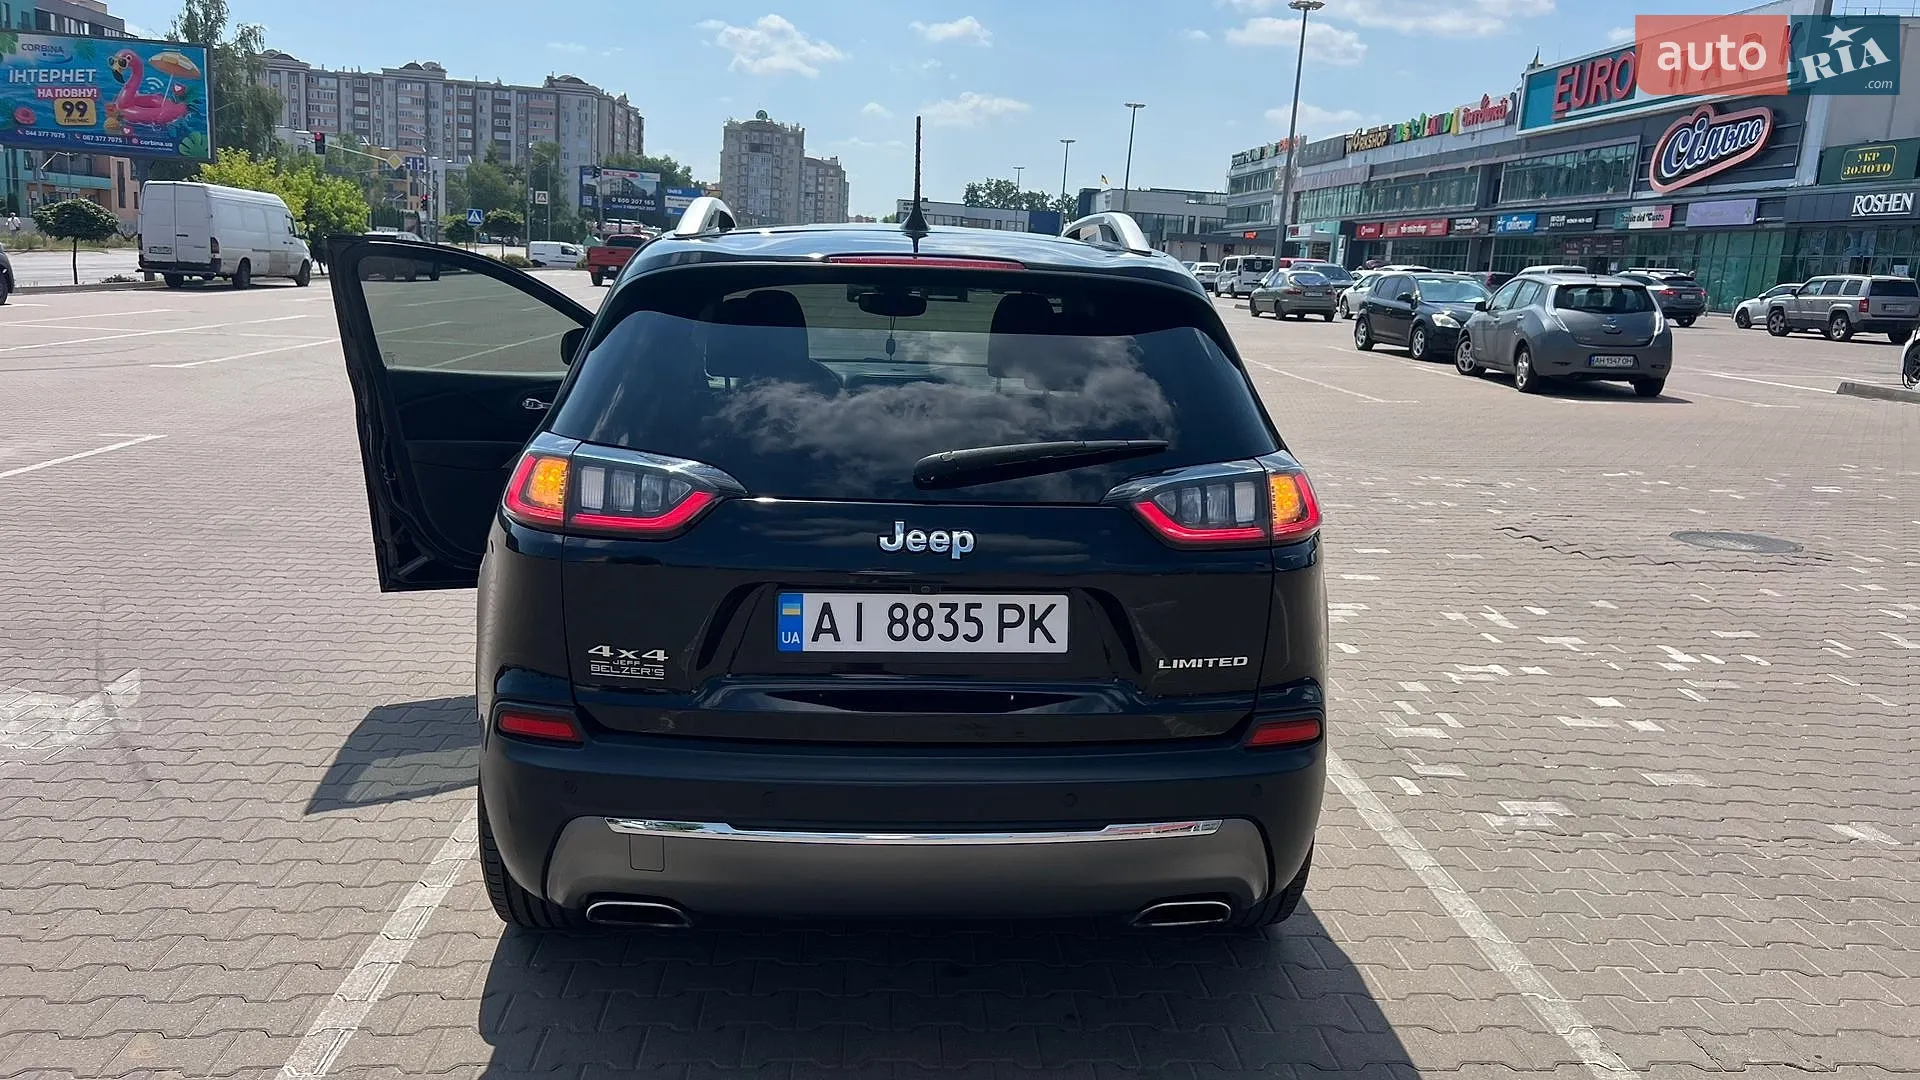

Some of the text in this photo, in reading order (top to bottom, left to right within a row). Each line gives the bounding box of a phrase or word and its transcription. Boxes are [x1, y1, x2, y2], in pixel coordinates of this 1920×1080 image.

[21, 43, 65, 54] CORBINA
[8, 68, 97, 83] ІНТЕРНЕТ
[1553, 52, 1637, 113] EURO
[37, 88, 98, 99] НА ПОВНУ!
[62, 101, 88, 118] 99
[1661, 116, 1764, 178] Сільпо
[1857, 151, 1880, 164] УКР
[1843, 161, 1892, 175] ЗОЛОТО
[1853, 192, 1915, 215] ROSHEN
[879, 520, 975, 560] Jeep
[811, 602, 1057, 644] AI 8835 PK
[782, 632, 801, 645] UA
[1158, 656, 1249, 669] LIMITED
[590, 664, 665, 677] BELZER'S
